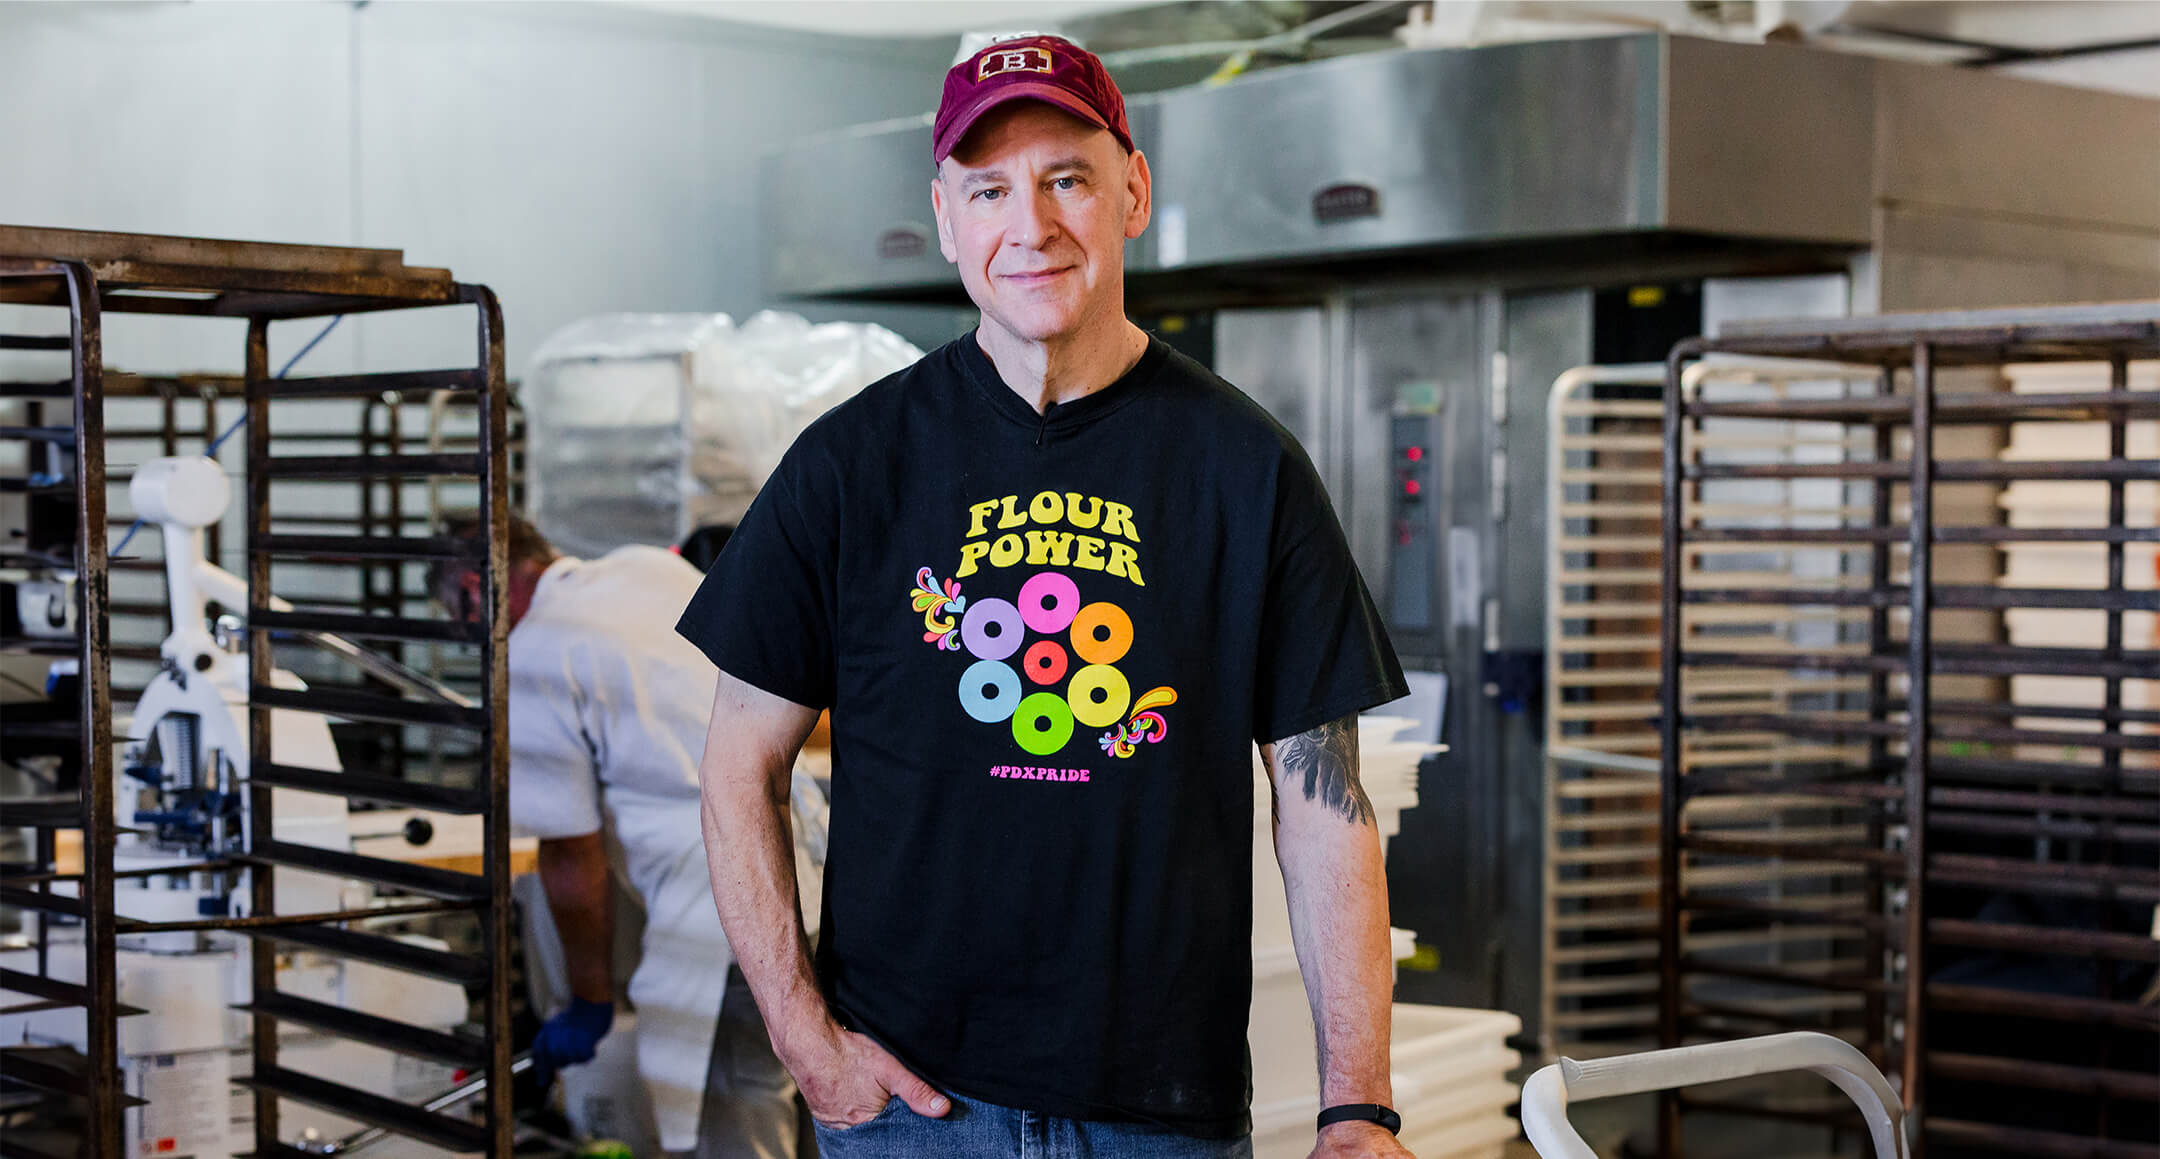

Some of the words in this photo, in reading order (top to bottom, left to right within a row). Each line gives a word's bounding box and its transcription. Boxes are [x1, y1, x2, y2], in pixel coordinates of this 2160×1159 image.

[1003, 53, 1026, 70] B
[966, 491, 1141, 543] FLOUR
[956, 530, 1145, 586] POWER
[990, 765, 1090, 782] #PDXPRIDE
